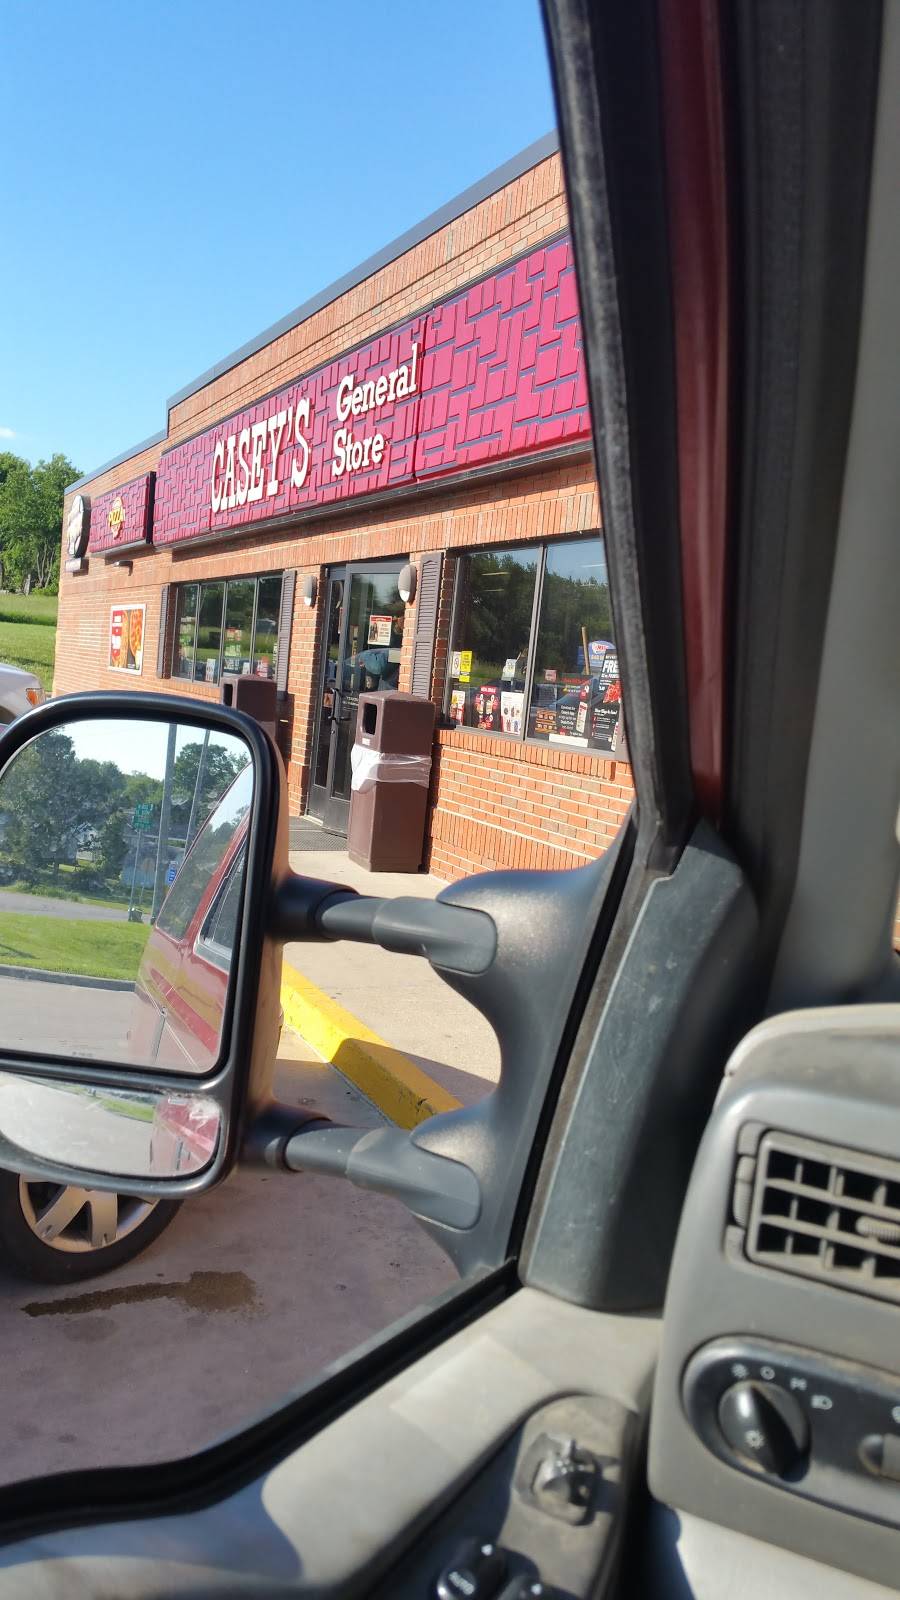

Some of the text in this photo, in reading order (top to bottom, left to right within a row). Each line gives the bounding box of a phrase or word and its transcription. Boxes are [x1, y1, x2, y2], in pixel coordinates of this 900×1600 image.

[335, 342, 418, 422] General
[210, 397, 311, 513] CASEY'S
[331, 428, 385, 477] Store
[602, 660, 619, 673] FRE
